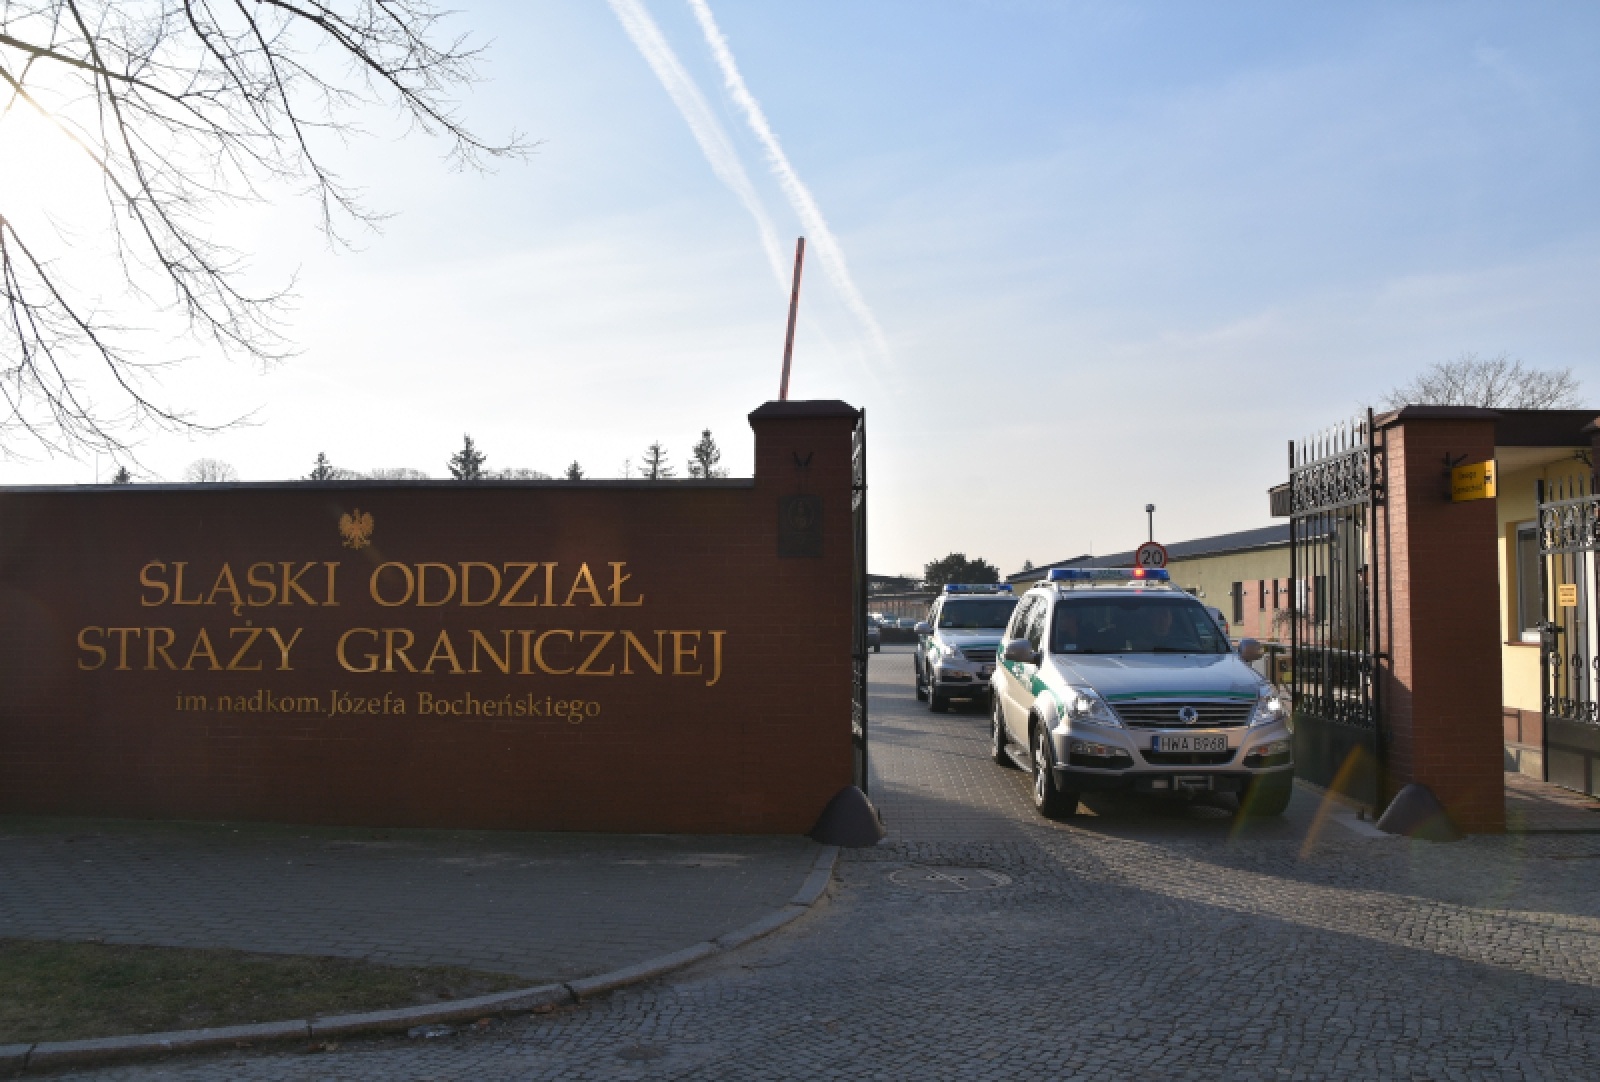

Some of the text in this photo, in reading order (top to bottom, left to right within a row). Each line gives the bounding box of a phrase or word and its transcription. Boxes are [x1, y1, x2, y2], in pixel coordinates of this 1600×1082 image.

[1141, 549, 1163, 565] 20
[369, 560, 645, 608] ODDZIAŁ
[76, 620, 727, 687] STRAŻY GRANICZNEJ
[327, 689, 407, 719] Józefa
[417, 691, 602, 725] Bocheńskiego
[1161, 737, 1190, 751] HWA
